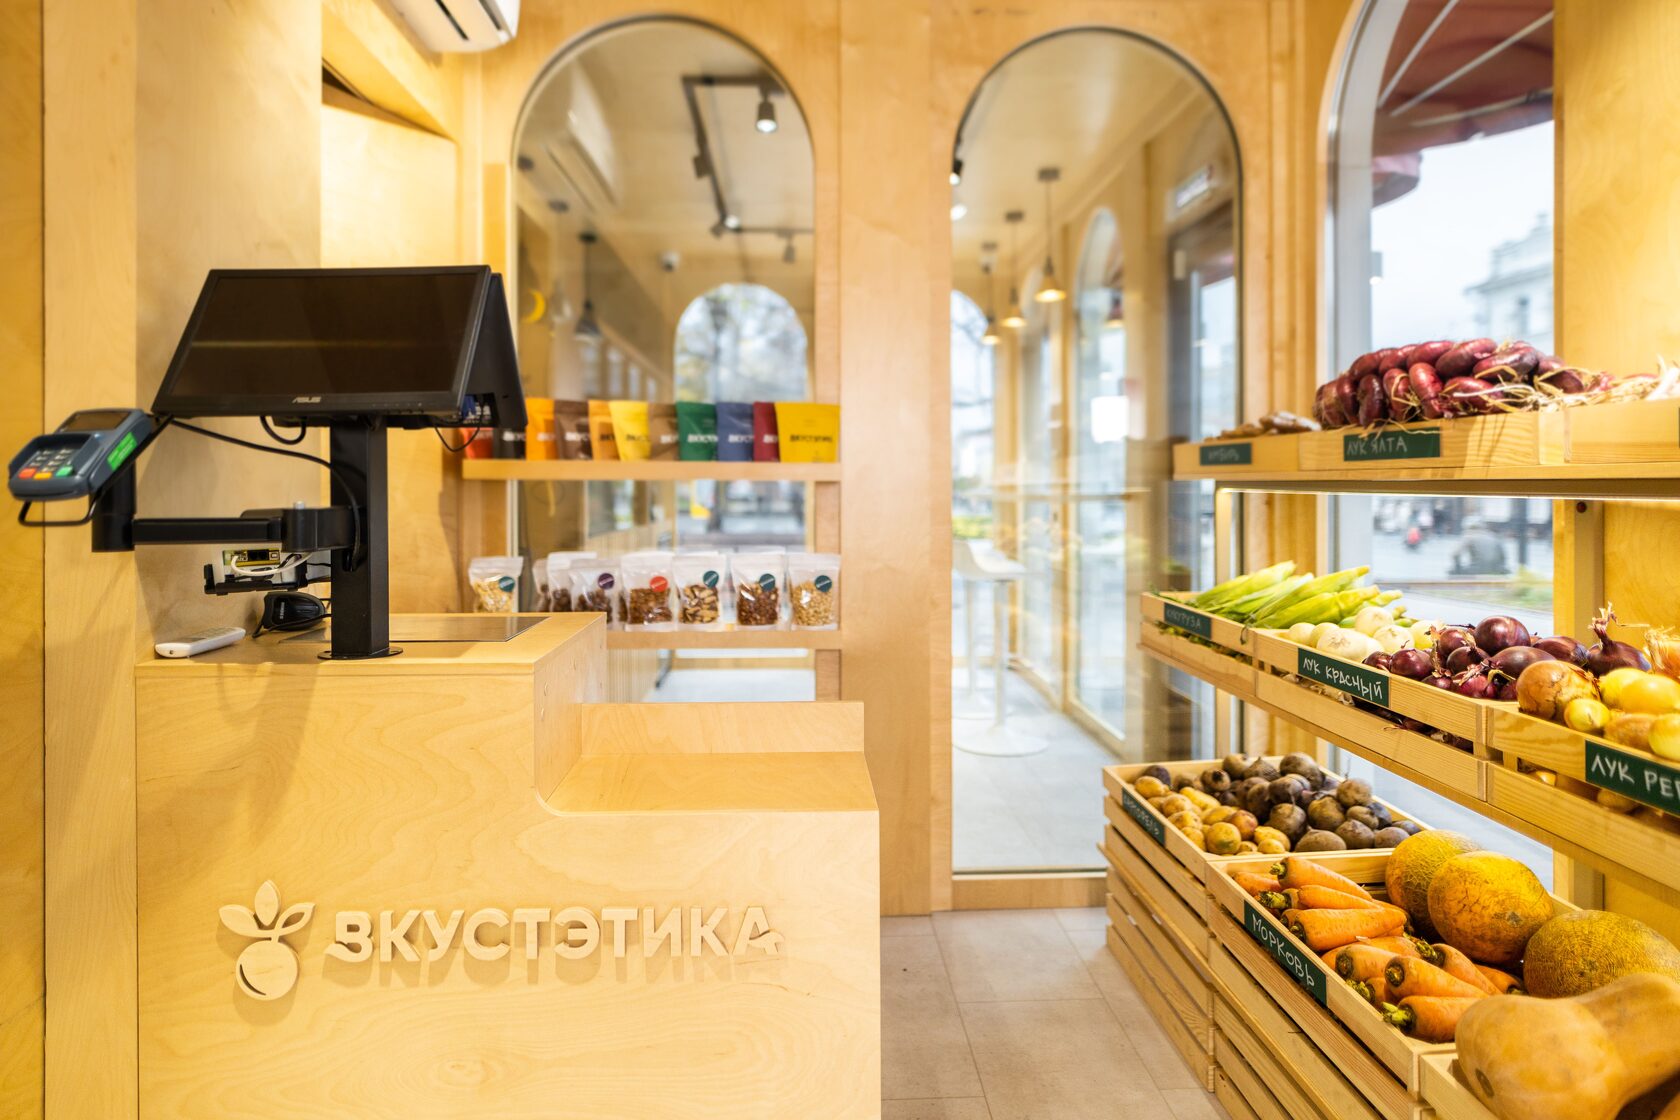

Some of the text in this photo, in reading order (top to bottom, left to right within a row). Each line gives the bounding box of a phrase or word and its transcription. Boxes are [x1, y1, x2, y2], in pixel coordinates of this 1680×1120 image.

[291, 396, 322, 404] ASUS
[1302, 656, 1384, 701] ЛУК КРАСНЫЙ
[1590, 752, 1636, 785] ЛУК
[322, 904, 787, 963] ВКУСТЭТИКА
[1252, 912, 1316, 988] МОРКОВЬ
